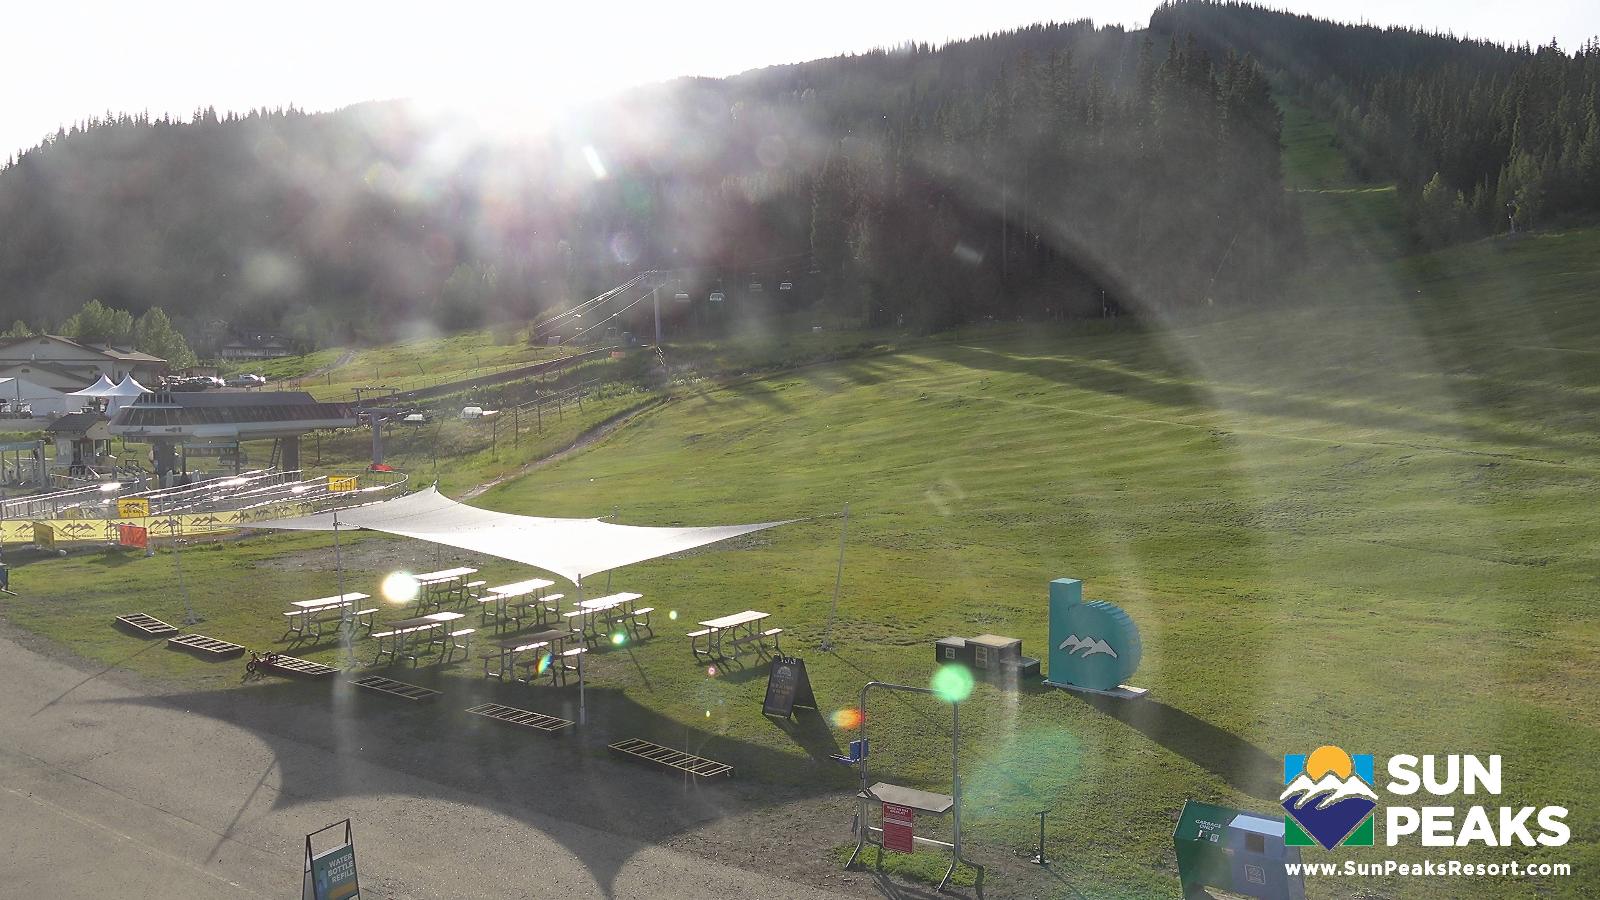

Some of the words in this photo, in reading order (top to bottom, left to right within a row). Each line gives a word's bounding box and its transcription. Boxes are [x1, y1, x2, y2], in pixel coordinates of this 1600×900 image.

[1199, 823, 1214, 831] ONLY
[328, 853, 353, 868] WATER
[327, 861, 353, 877] BOTTLE
[331, 869, 355, 883] REFILL
